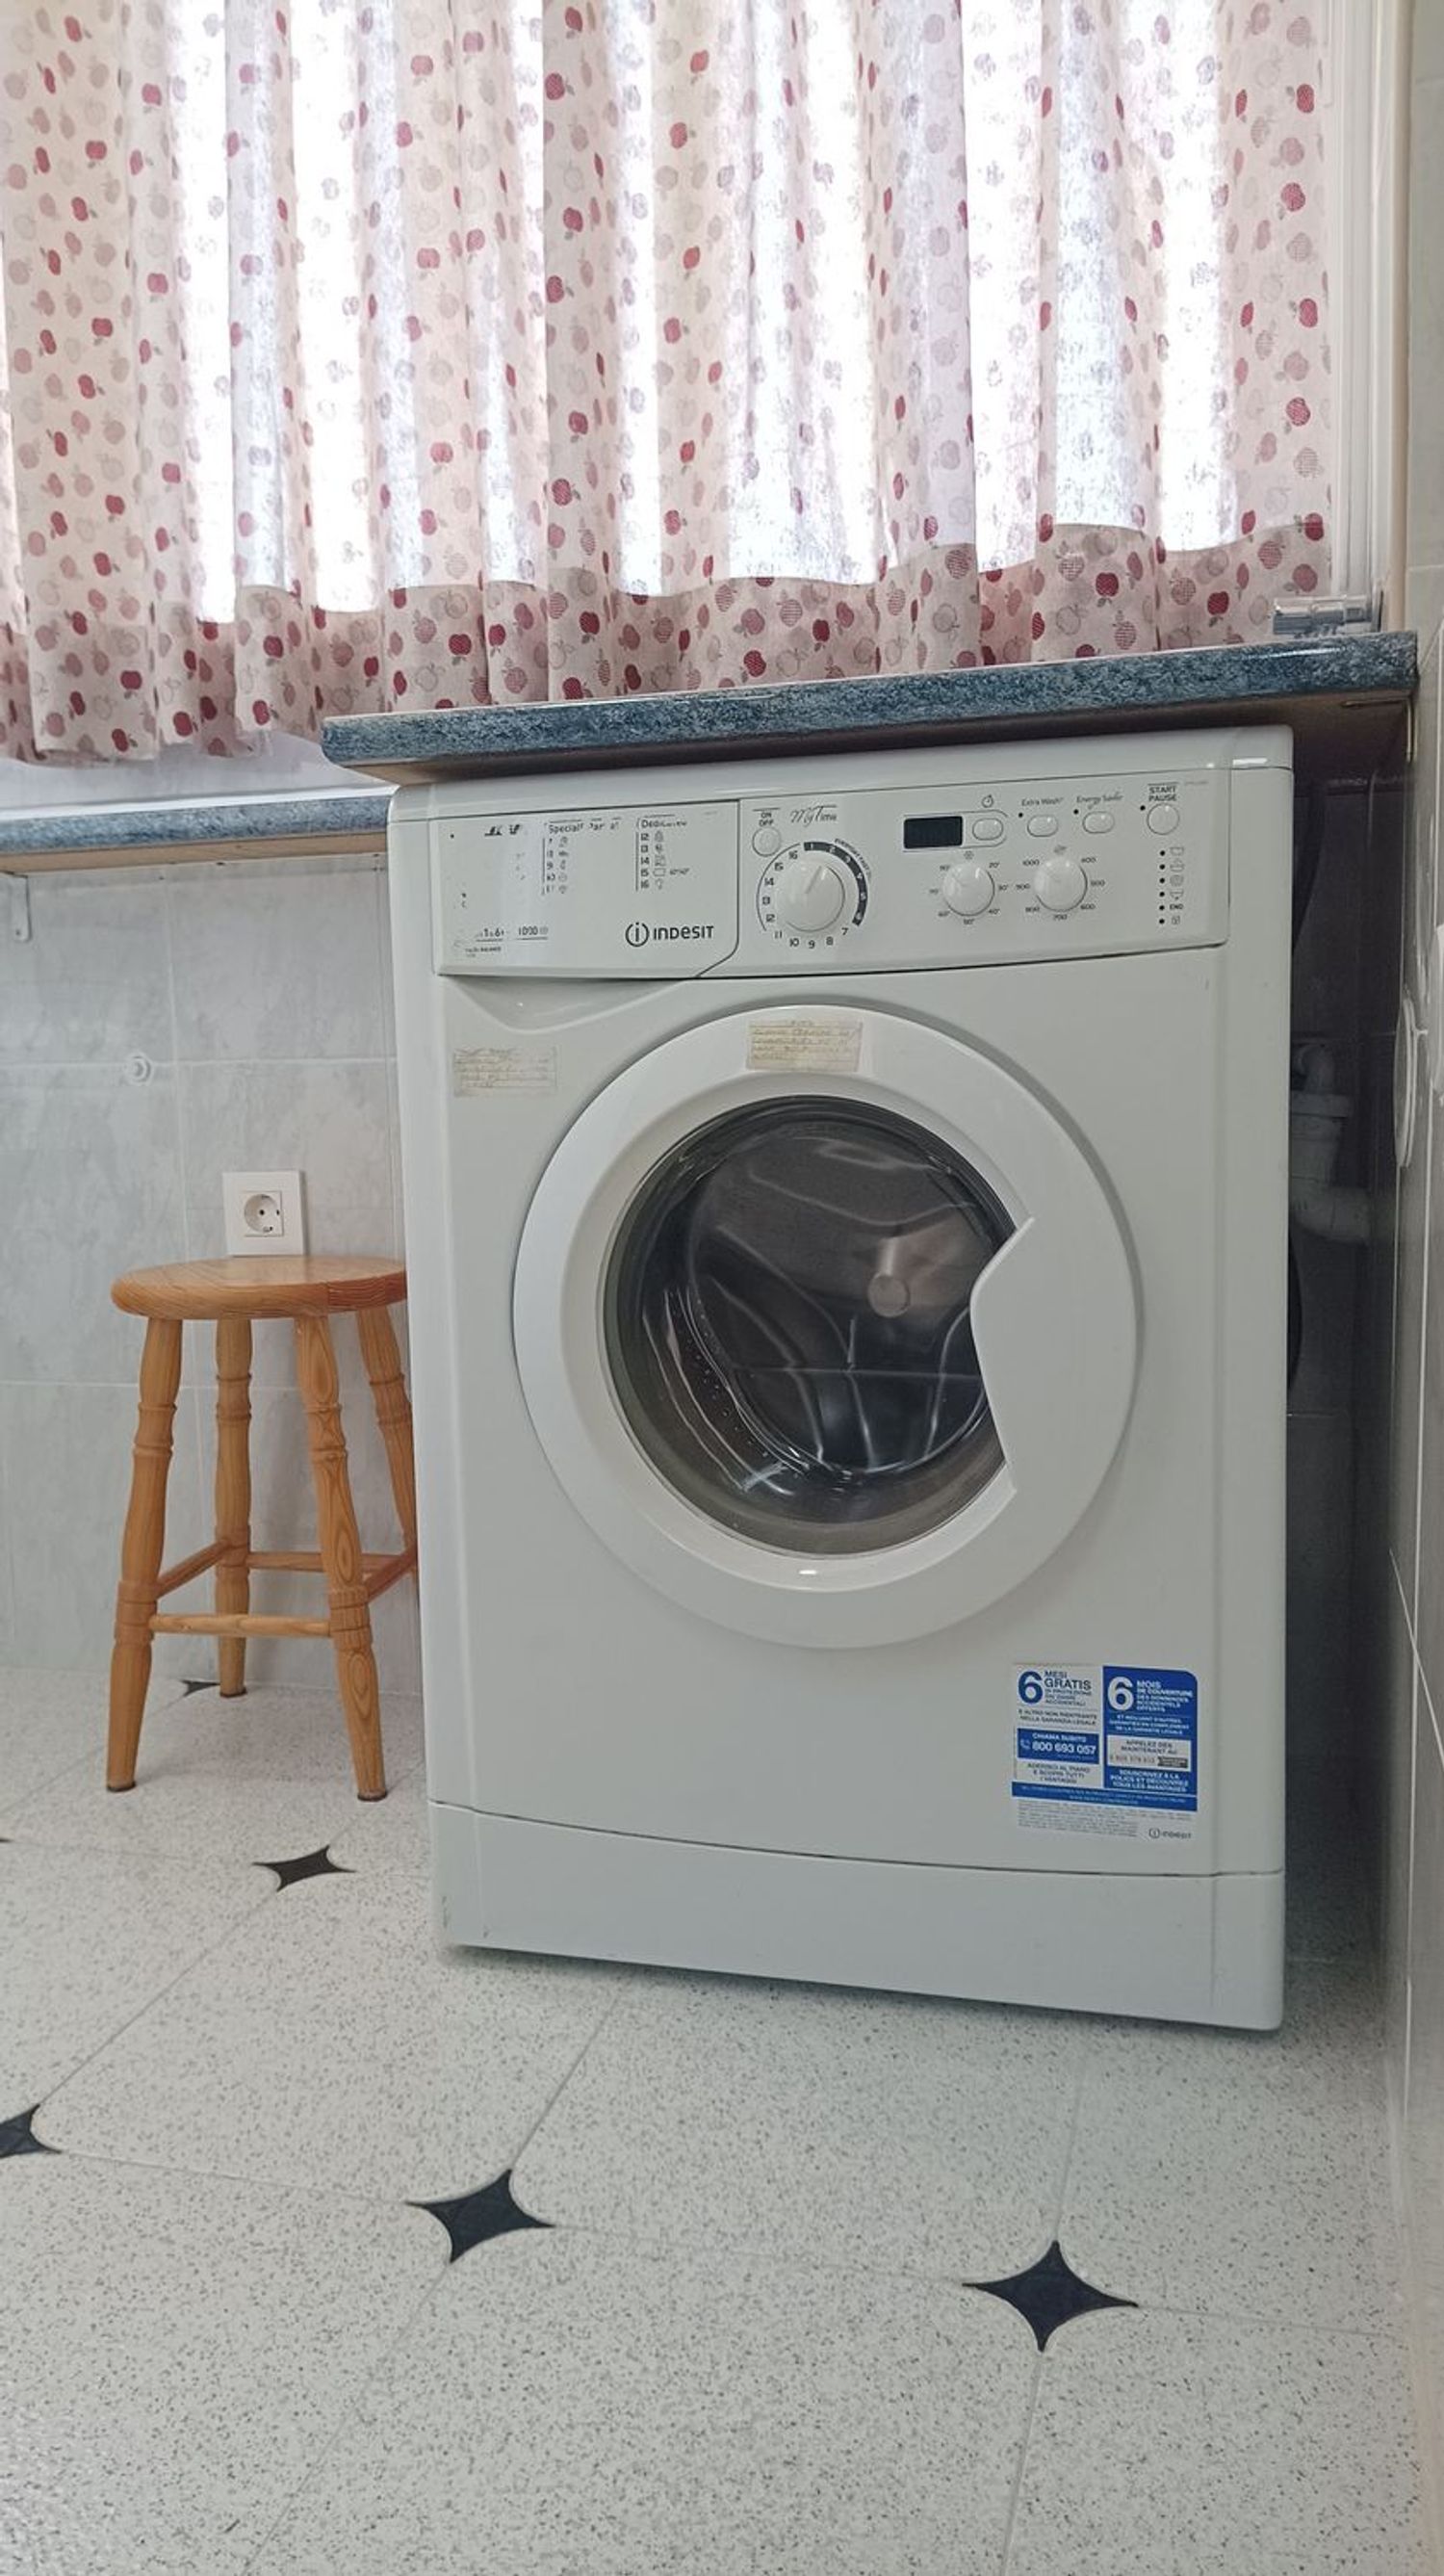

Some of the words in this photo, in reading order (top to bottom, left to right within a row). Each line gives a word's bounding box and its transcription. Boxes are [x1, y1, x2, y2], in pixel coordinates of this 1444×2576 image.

[1148, 785, 1176, 794] START
[1148, 794, 1176, 802] PAUSE
[788, 850, 798, 860] 16
[653, 924, 714, 940] INDESIT
[774, 930, 783, 939] 11
[841, 926, 849, 936] 7
[789, 938, 800, 948] 10
[808, 940, 816, 950] 9
[825, 936, 834, 946] 8
[1044, 1670, 1068, 1678] MESI
[1018, 1671, 1044, 1704] 6
[1044, 1678, 1092, 1691] GRATIS
[1137, 1679, 1162, 1689] MOIS
[1108, 1676, 1134, 1712] 6
[1032, 1741, 1053, 1752] 800
[1054, 1743, 1074, 1754] 693
[1076, 1744, 1096, 1756] 057
